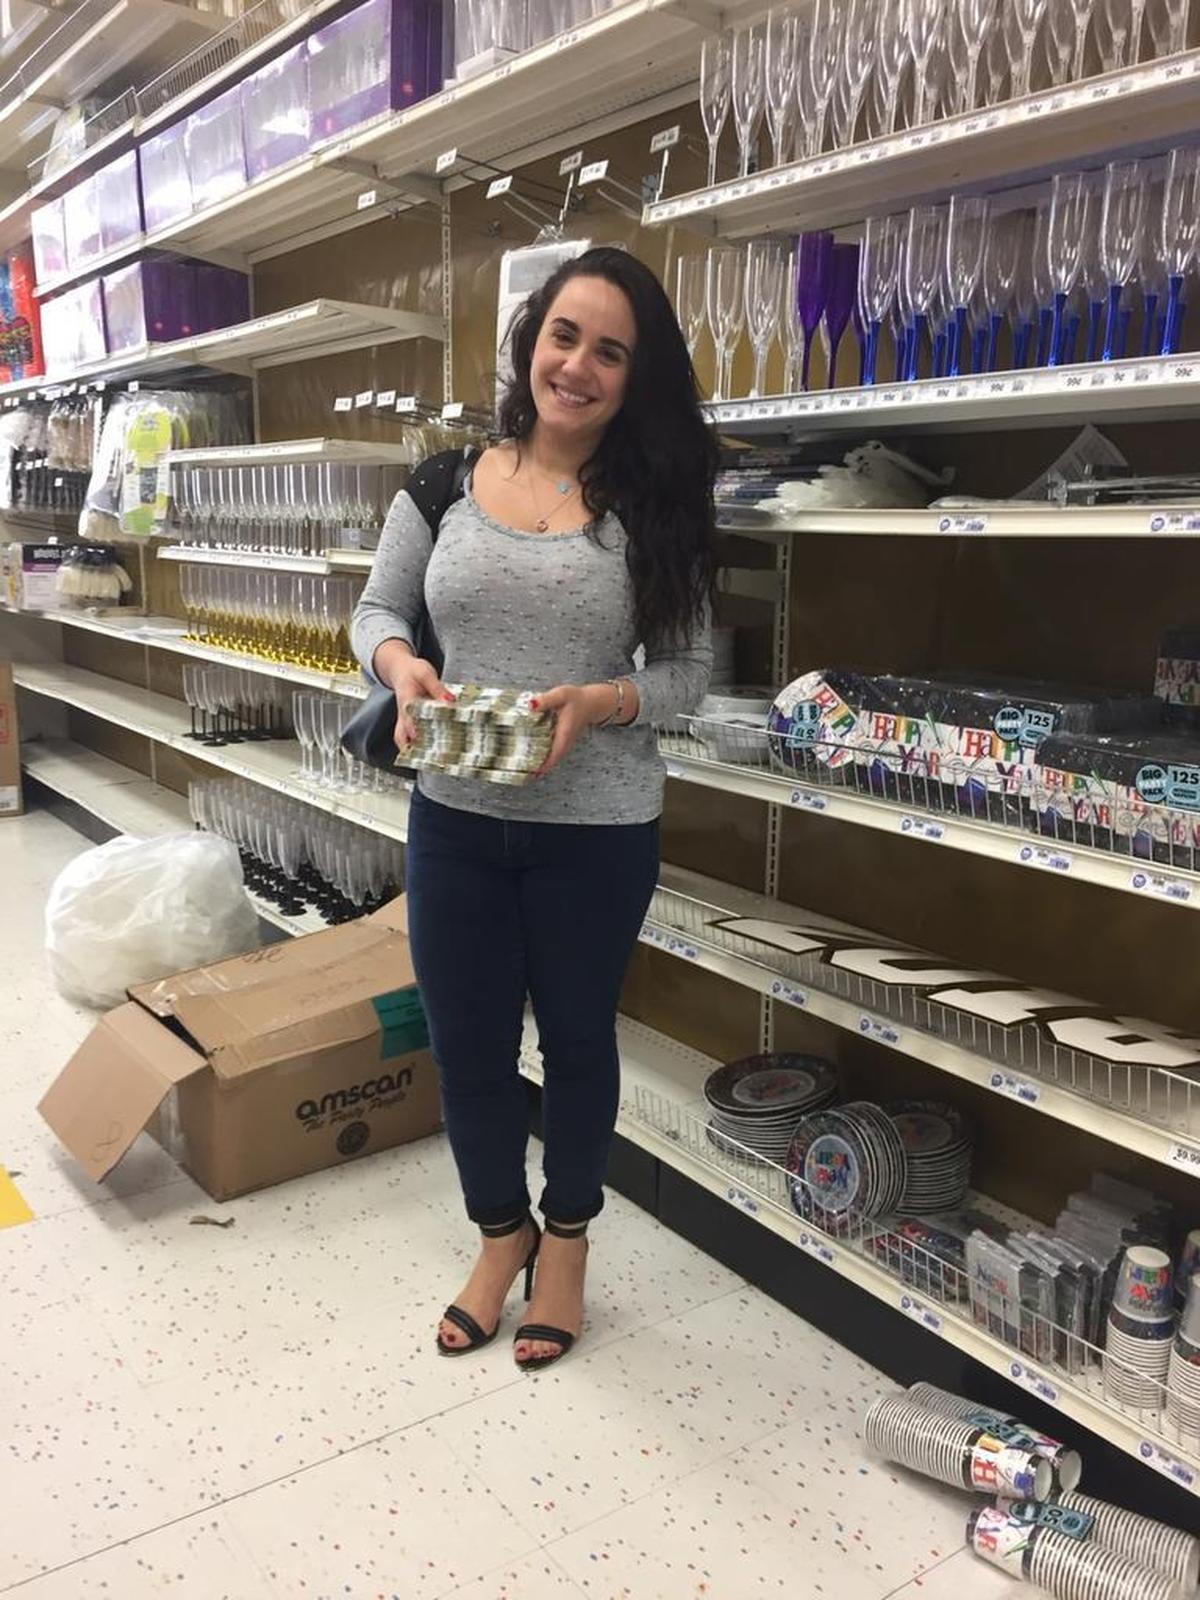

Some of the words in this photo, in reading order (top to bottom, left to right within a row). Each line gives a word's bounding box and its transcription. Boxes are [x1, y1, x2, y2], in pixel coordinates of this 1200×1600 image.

[1174, 367, 1193, 378] 99¢
[1066, 376, 1082, 387] 99¢
[1001, 711, 1020, 720] BIG
[1027, 713, 1050, 728] 125
[1141, 769, 1162, 780] BIG
[1171, 770, 1200, 785] 125
[1141, 788, 1165, 796] PACK
[295, 1067, 413, 1121] amscan
[1044, 1508, 1063, 1525] 50
